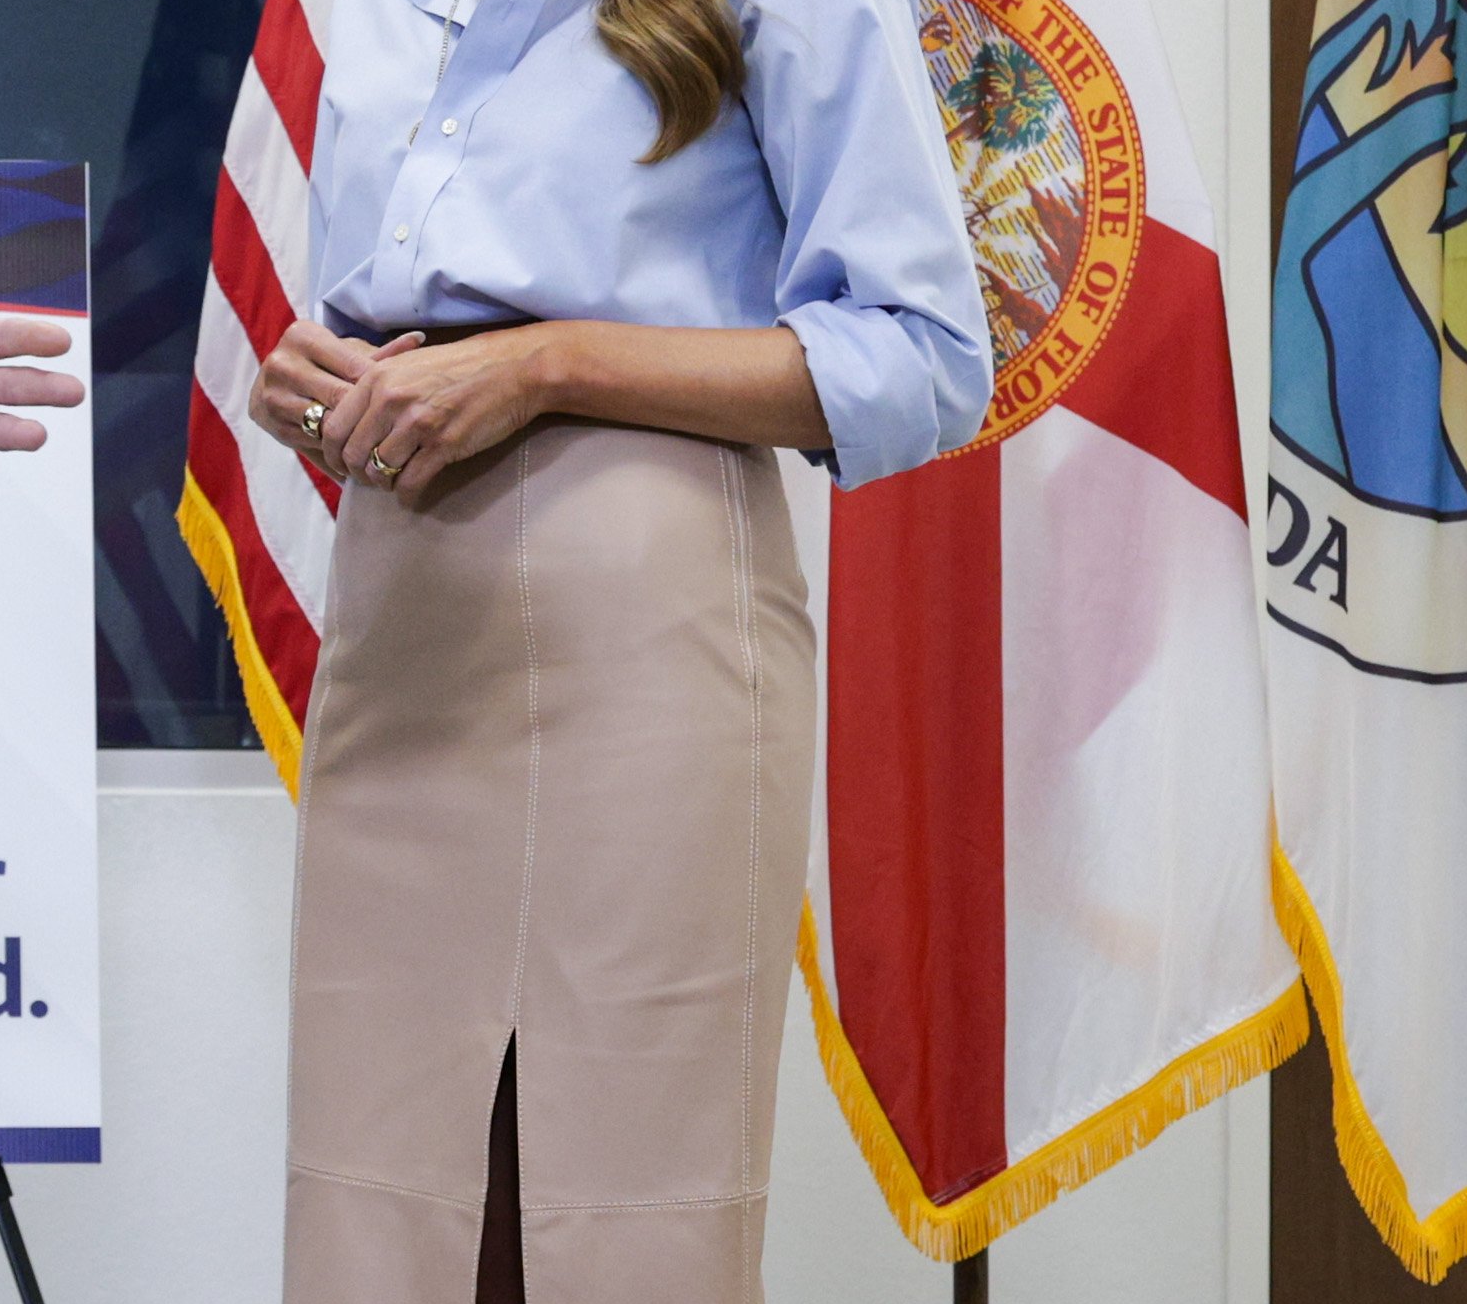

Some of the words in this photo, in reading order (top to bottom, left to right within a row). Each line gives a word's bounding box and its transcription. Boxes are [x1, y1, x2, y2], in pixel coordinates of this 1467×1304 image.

[1030, 3, 1101, 92] THE
[1088, 101, 1131, 238] STATE
[1078, 260, 1118, 323] OF
[981, 328, 1084, 430] FLOR
